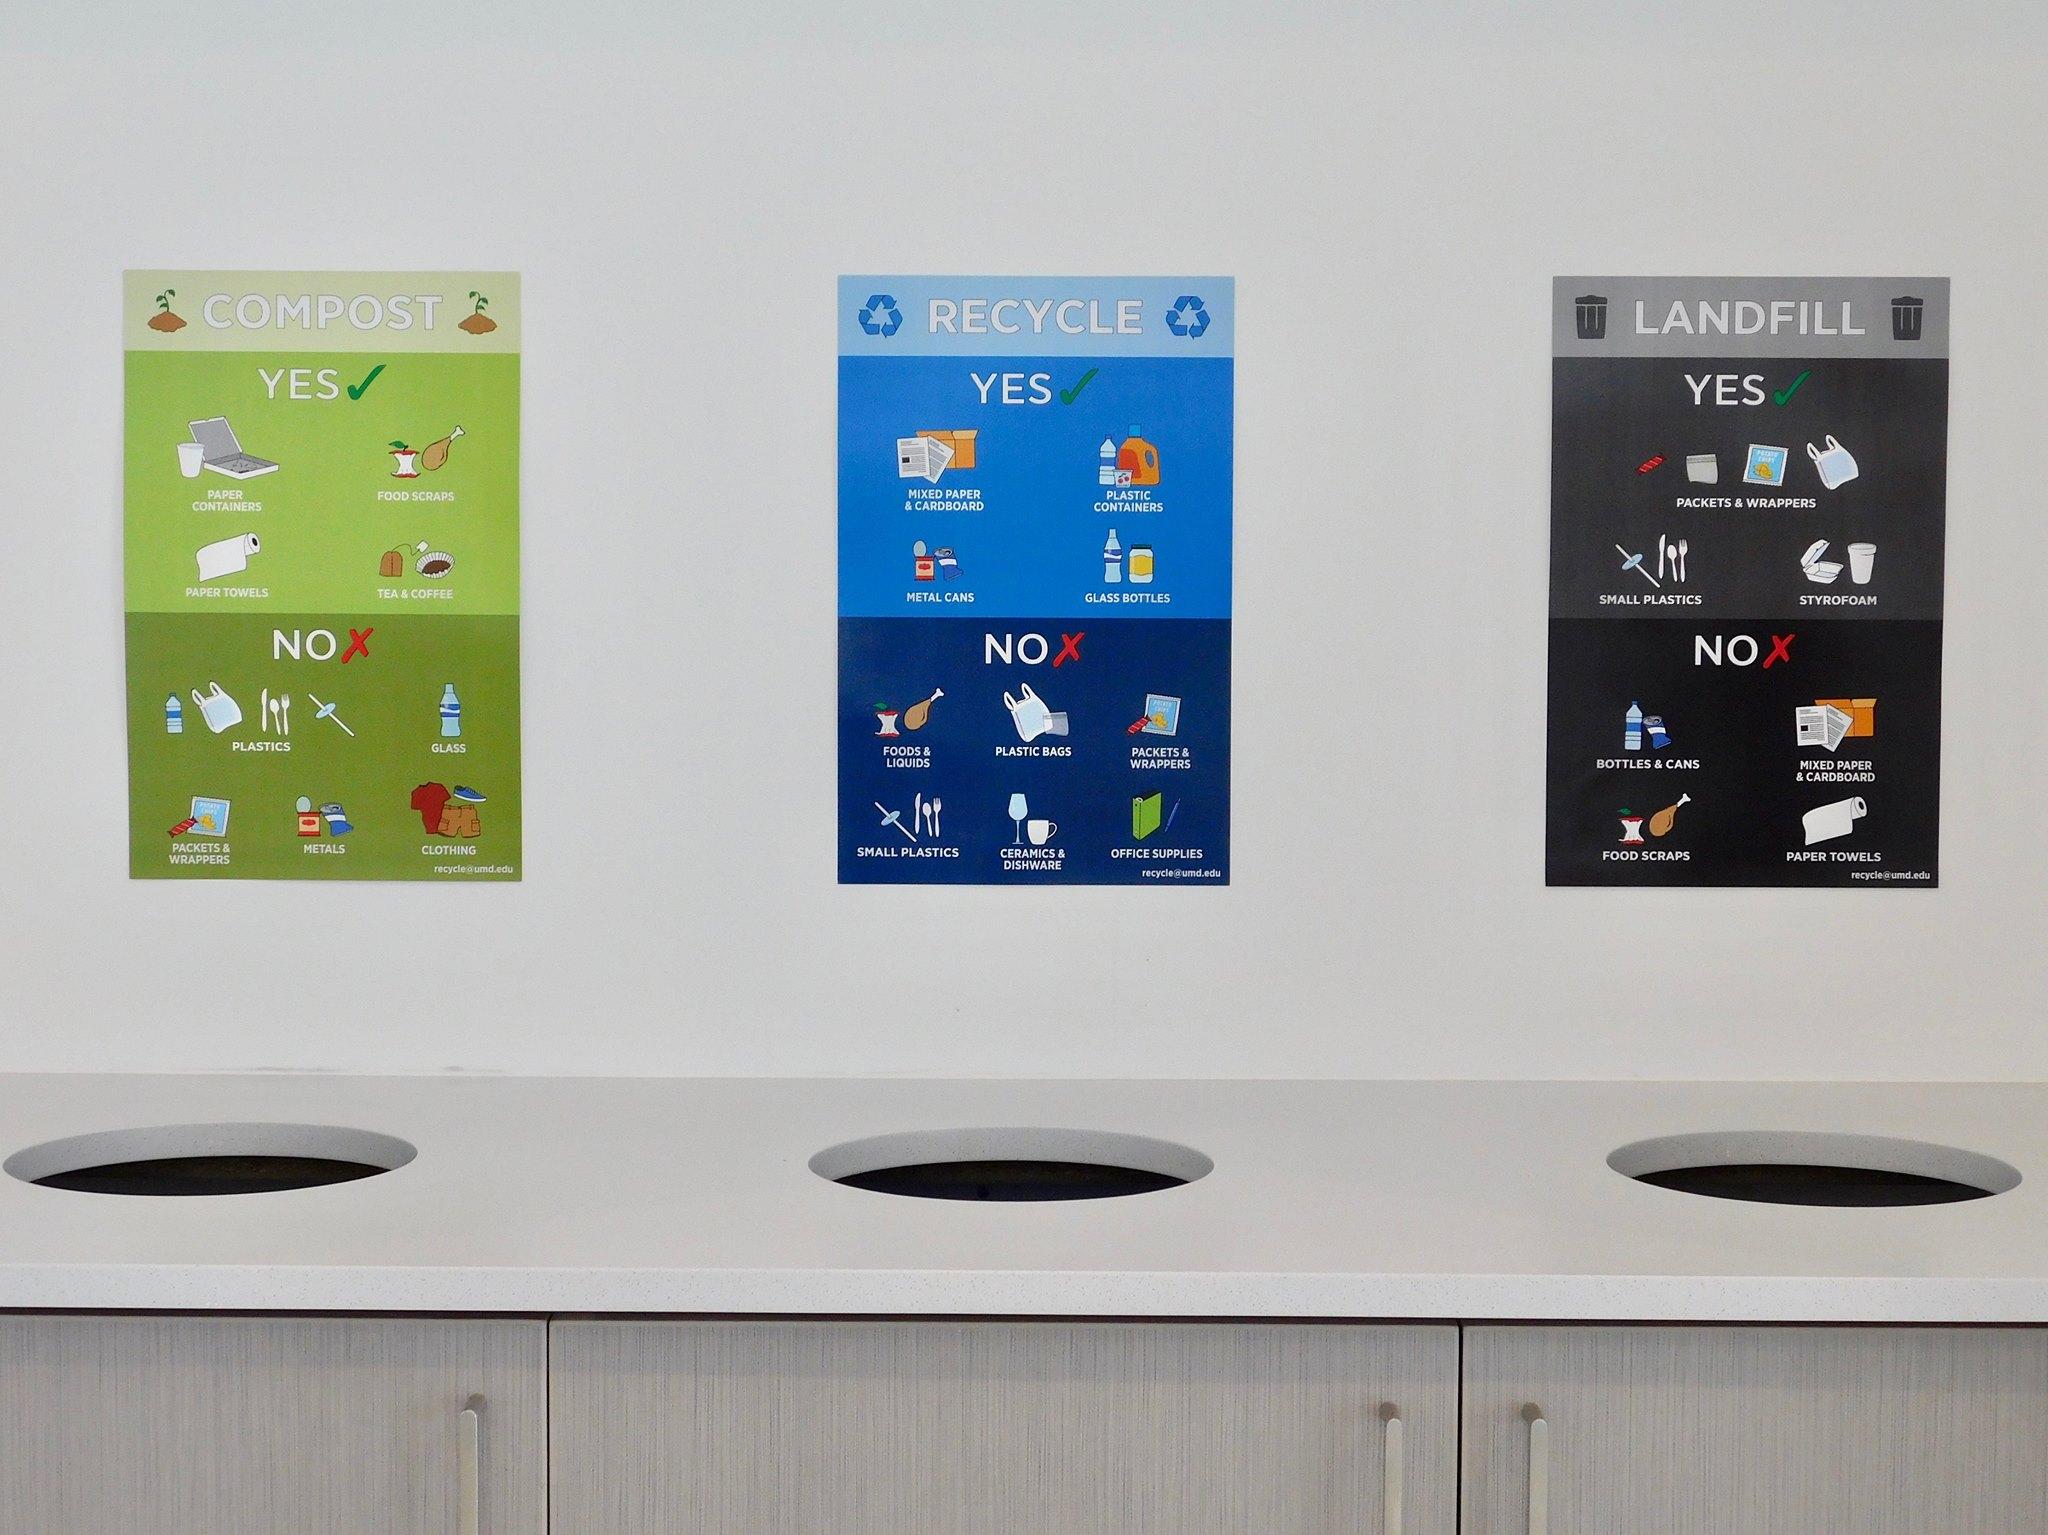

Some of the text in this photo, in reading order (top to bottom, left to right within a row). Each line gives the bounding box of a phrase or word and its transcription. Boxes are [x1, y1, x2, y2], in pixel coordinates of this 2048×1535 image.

[204, 293, 441, 331] COMPOST
[930, 300, 1144, 336] RECYCLE
[1636, 301, 1865, 336] LANDFILL
[258, 369, 339, 399] YES
[971, 373, 1051, 404] YES
[1685, 375, 1765, 405] YES
[208, 490, 243, 501] PAPER
[378, 491, 454, 501] FOOD SCRAPS
[909, 489, 980, 500] MIXED PAPER
[1107, 491, 1150, 500] PLASTIC
[193, 502, 261, 511] CONTAINERS
[905, 501, 984, 511] & CARDBOARD
[1094, 501, 1163, 512] CONTAINERS
[1677, 498, 1816, 508] PACKETS & WRAPPERS
[186, 588, 268, 597] PAPER TOWELS
[378, 589, 452, 598] TEA & COFFEE
[907, 593, 974, 602] METAL CANS
[1085, 593, 1170, 603] GLASS BOTTLES
[1600, 595, 1701, 604] SMALL PLASTICS
[1800, 596, 1876, 605] STYROFOAM
[274, 630, 336, 660] NO
[986, 634, 1048, 664] NO
[1695, 635, 1758, 666] NO
[233, 742, 290, 751] PLASTICS
[432, 744, 466, 753] GLASS
[996, 747, 1071, 756] PLASTIC BAGS
[884, 747, 930, 758] FOODS &
[1132, 748, 1189, 758] PACKETS &
[887, 757, 930, 767] LIQUIDS
[1131, 758, 1190, 769] WRAPPERS
[1597, 759, 1699, 769] BOTTLES & CANS
[1800, 761, 1872, 772] MIXED PAPER
[1796, 772, 1875, 781] & CARDBOARD
[173, 843, 230, 854] PACKETS &
[304, 844, 345, 853] METALS
[422, 846, 476, 855] CLOTHING
[858, 847, 959, 857] SMALL PLASTICS
[1111, 849, 1202, 858] OFFICE SUPPLIES
[169, 853, 229, 864] WRAPPERS
[1001, 849, 1065, 860] CERAMICS &
[1603, 851, 1690, 860] FOOD SCRAPS
[1787, 852, 1881, 861] PAPER TOWELS
[434, 865, 513, 874] recycle@umd.edu
[1004, 859, 1061, 870] DISHWARE
[1143, 869, 1220, 878] recycle@umd.edu
[1852, 871, 1930, 880] recycle@umd.edu
